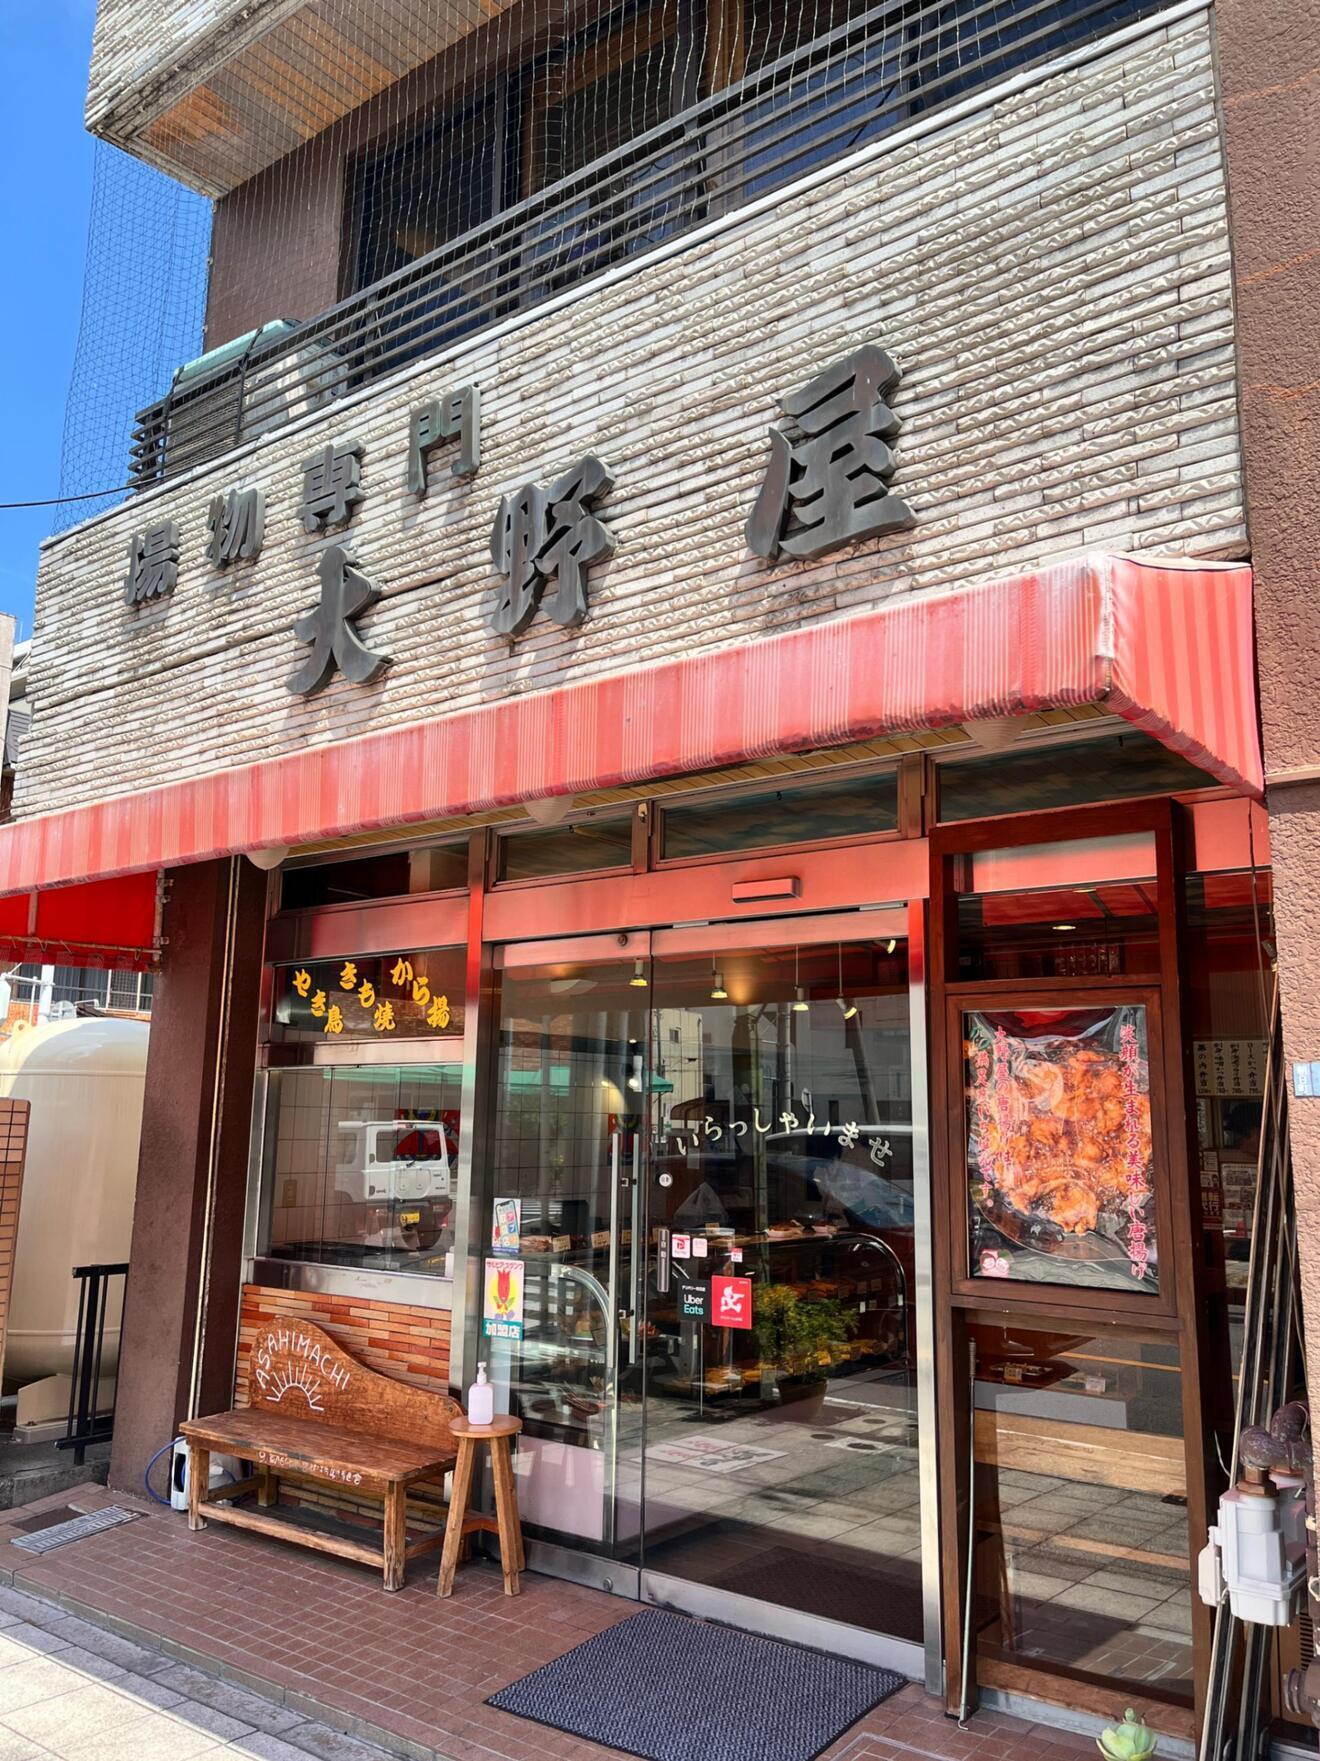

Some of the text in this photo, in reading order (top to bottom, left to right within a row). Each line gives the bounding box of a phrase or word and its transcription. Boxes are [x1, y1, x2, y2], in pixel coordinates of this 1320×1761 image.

[286, 343, 918, 698] 大野屋
[292, 968, 344, 1035] やき鳥
[340, 961, 396, 1032] きも焼
[390, 957, 451, 1029] から揚
[676, 1107, 893, 1167] いらっしゃいませ
[1119, 1023, 1148, 1281] 笑顔が生まれる美味しい唐揚げ
[485, 1323, 520, 1339] 加盟店
[683, 1293, 704, 1305] Uber
[683, 1304, 704, 1315] Eats
[255, 1329, 351, 1390] ASAHIMACHI
